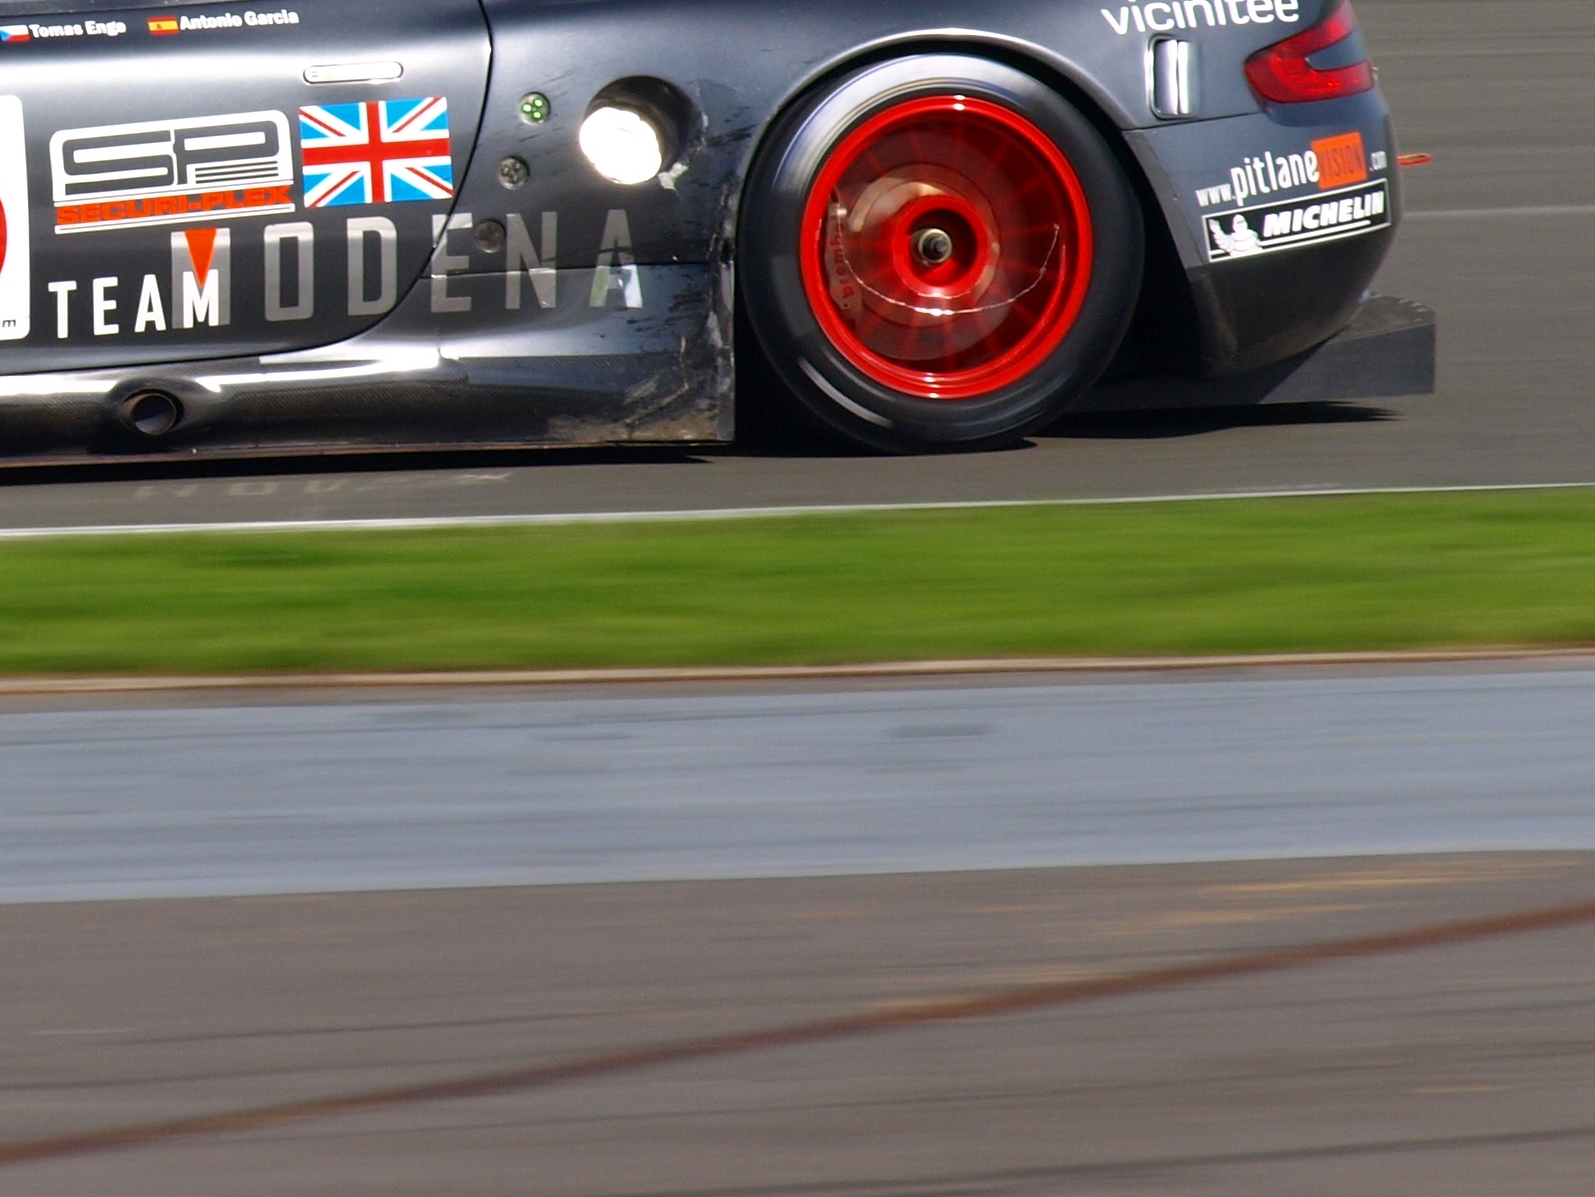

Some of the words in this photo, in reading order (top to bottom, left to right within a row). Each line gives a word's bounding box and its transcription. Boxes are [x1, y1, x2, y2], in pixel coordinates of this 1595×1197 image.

[30, 22, 84, 39] Tomas
[179, 13, 243, 31] Antonio
[244, 9, 300, 27] Garcia
[56, 184, 292, 226] SECURI-PLEX
[1262, 190, 1385, 238] MICHELIN
[47, 267, 220, 339] TEAM
[170, 208, 645, 330] MODENA
